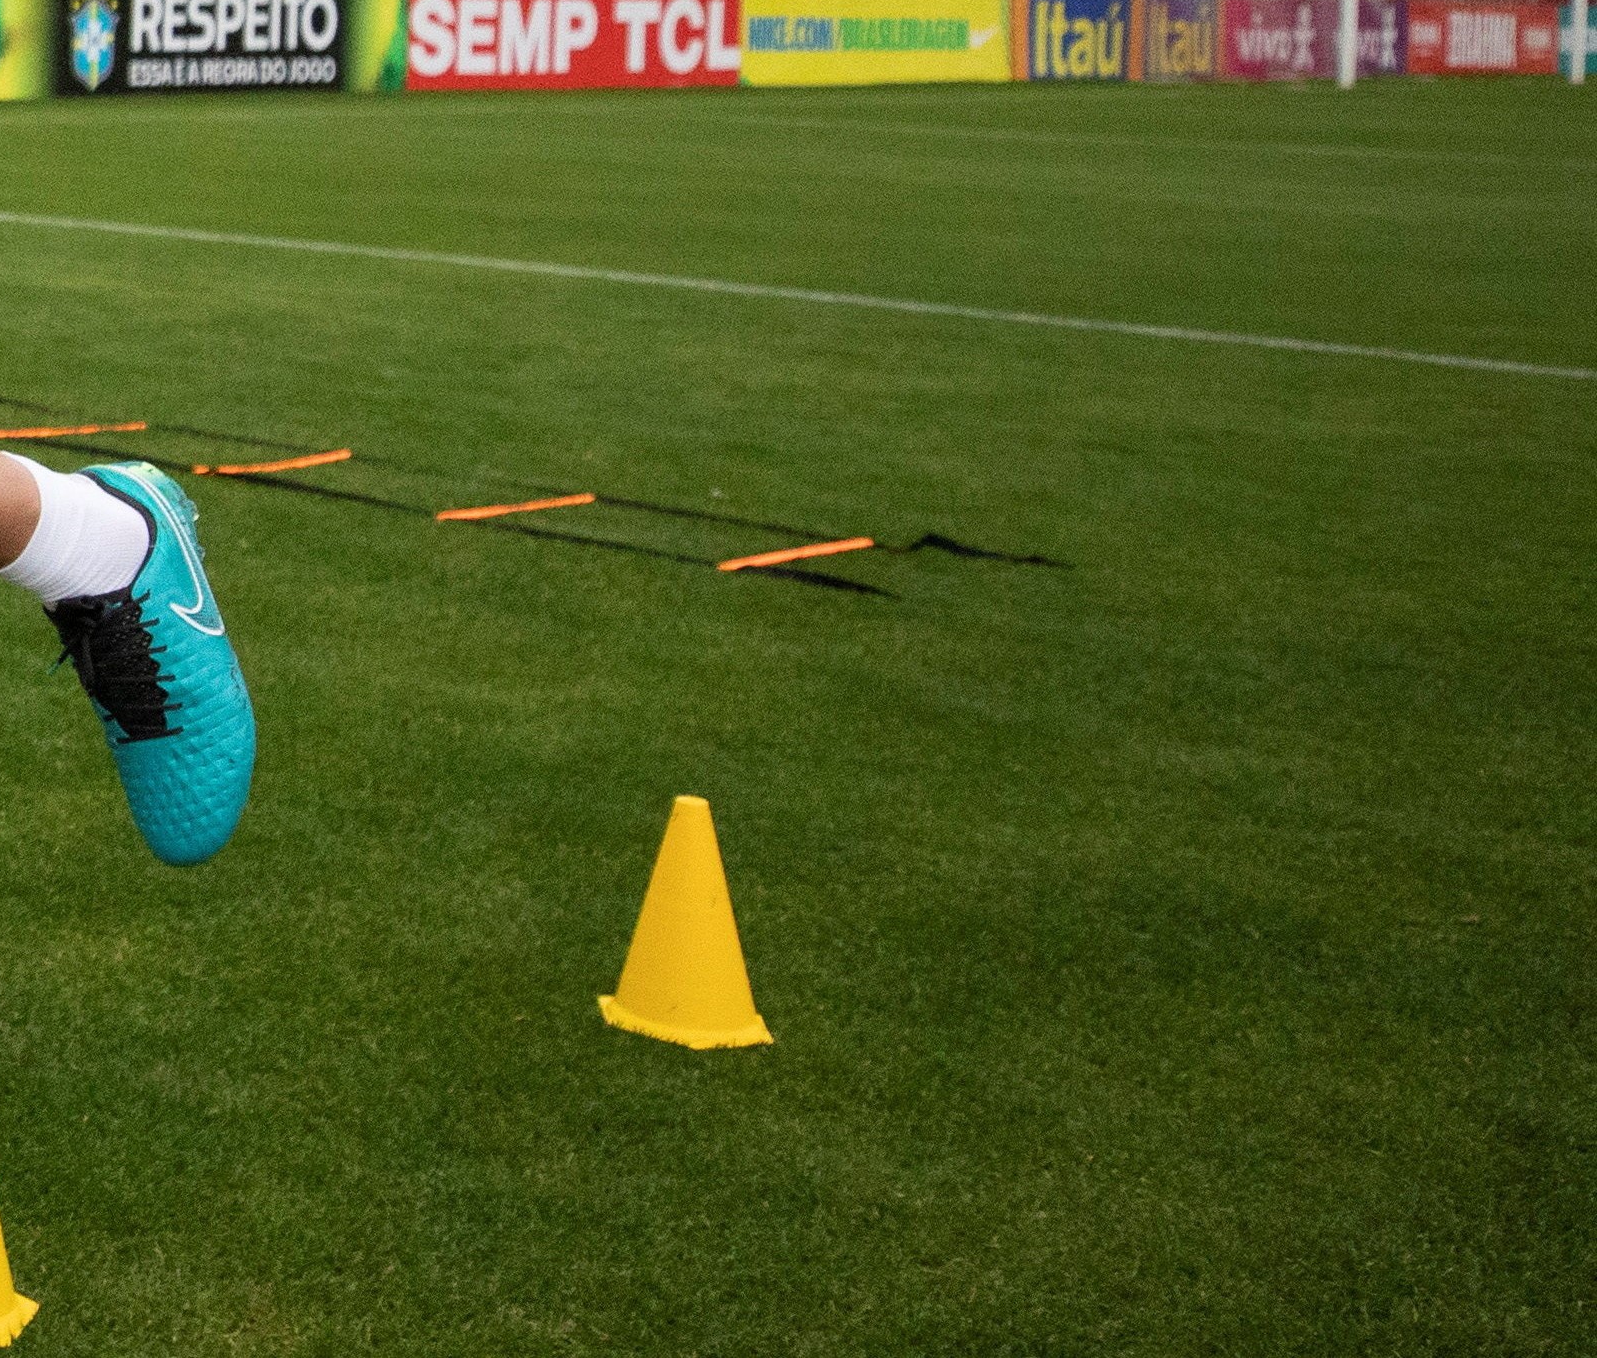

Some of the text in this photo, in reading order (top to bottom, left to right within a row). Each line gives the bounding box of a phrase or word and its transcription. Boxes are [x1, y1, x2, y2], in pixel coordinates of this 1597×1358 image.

[1034, 0, 1125, 77] Itaú
[127, 58, 172, 87] ESSA
[187, 58, 200, 84] A
[261, 56, 288, 84] DO
